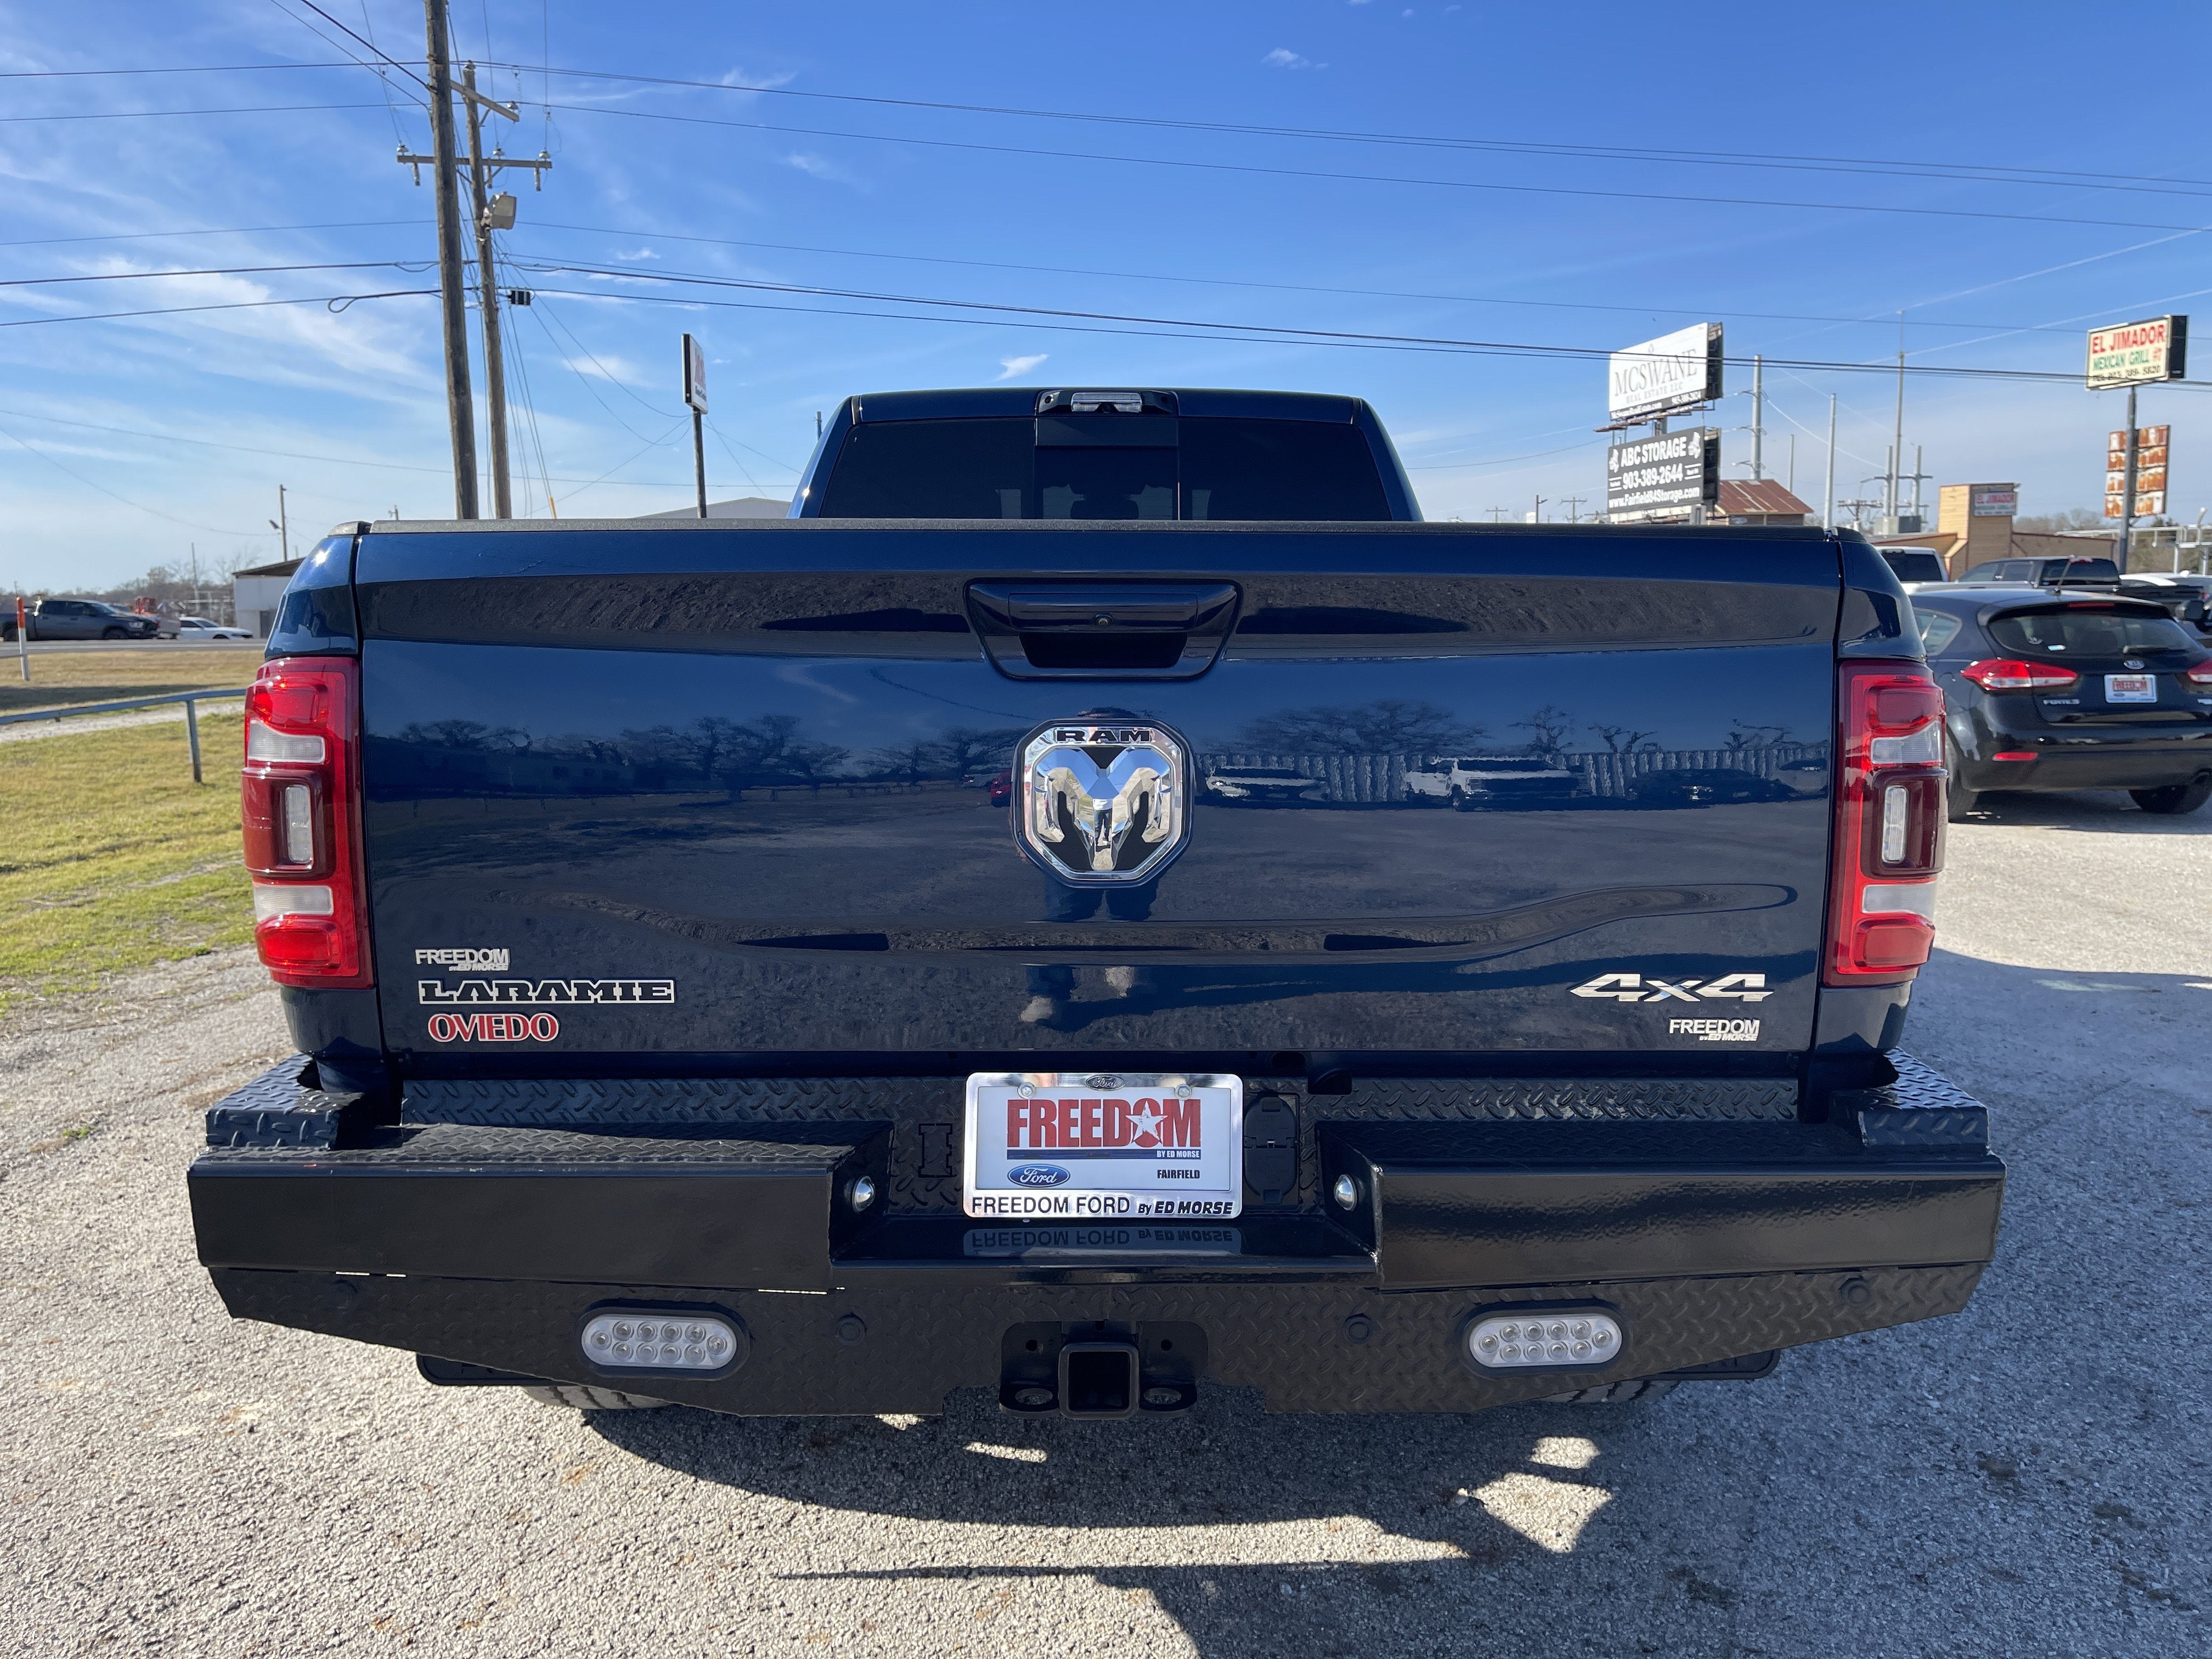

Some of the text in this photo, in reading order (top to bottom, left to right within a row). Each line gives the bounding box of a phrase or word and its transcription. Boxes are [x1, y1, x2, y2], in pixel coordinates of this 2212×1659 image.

[2093, 324, 2165, 353] EL JIMADOR
[1644, 386, 1668, 399] ESTATE
[1621, 436, 1687, 467] ABC STORAGE
[1623, 463, 1683, 489] 903-389-2644
[1055, 730, 1151, 742] RAM
[415, 949, 510, 964] FREEDOM
[418, 979, 675, 1005] LARAMIE
[428, 1012, 560, 1042] OVIEDO
[1669, 1019, 1760, 1034] FREEDOM
[1722, 1033, 1758, 1041] MORSE
[1007, 1098, 1201, 1148] FREEDOM
[1176, 1150, 1200, 1158] MORSE
[1020, 1167, 1058, 1184] Ford
[1157, 1169, 1200, 1179] FAIRFIELD
[972, 1197, 1069, 1214] FREEDOM
[1076, 1196, 1130, 1214] FORD
[1154, 1201, 1175, 1215] ED
[1177, 1201, 1233, 1215] MORSE
